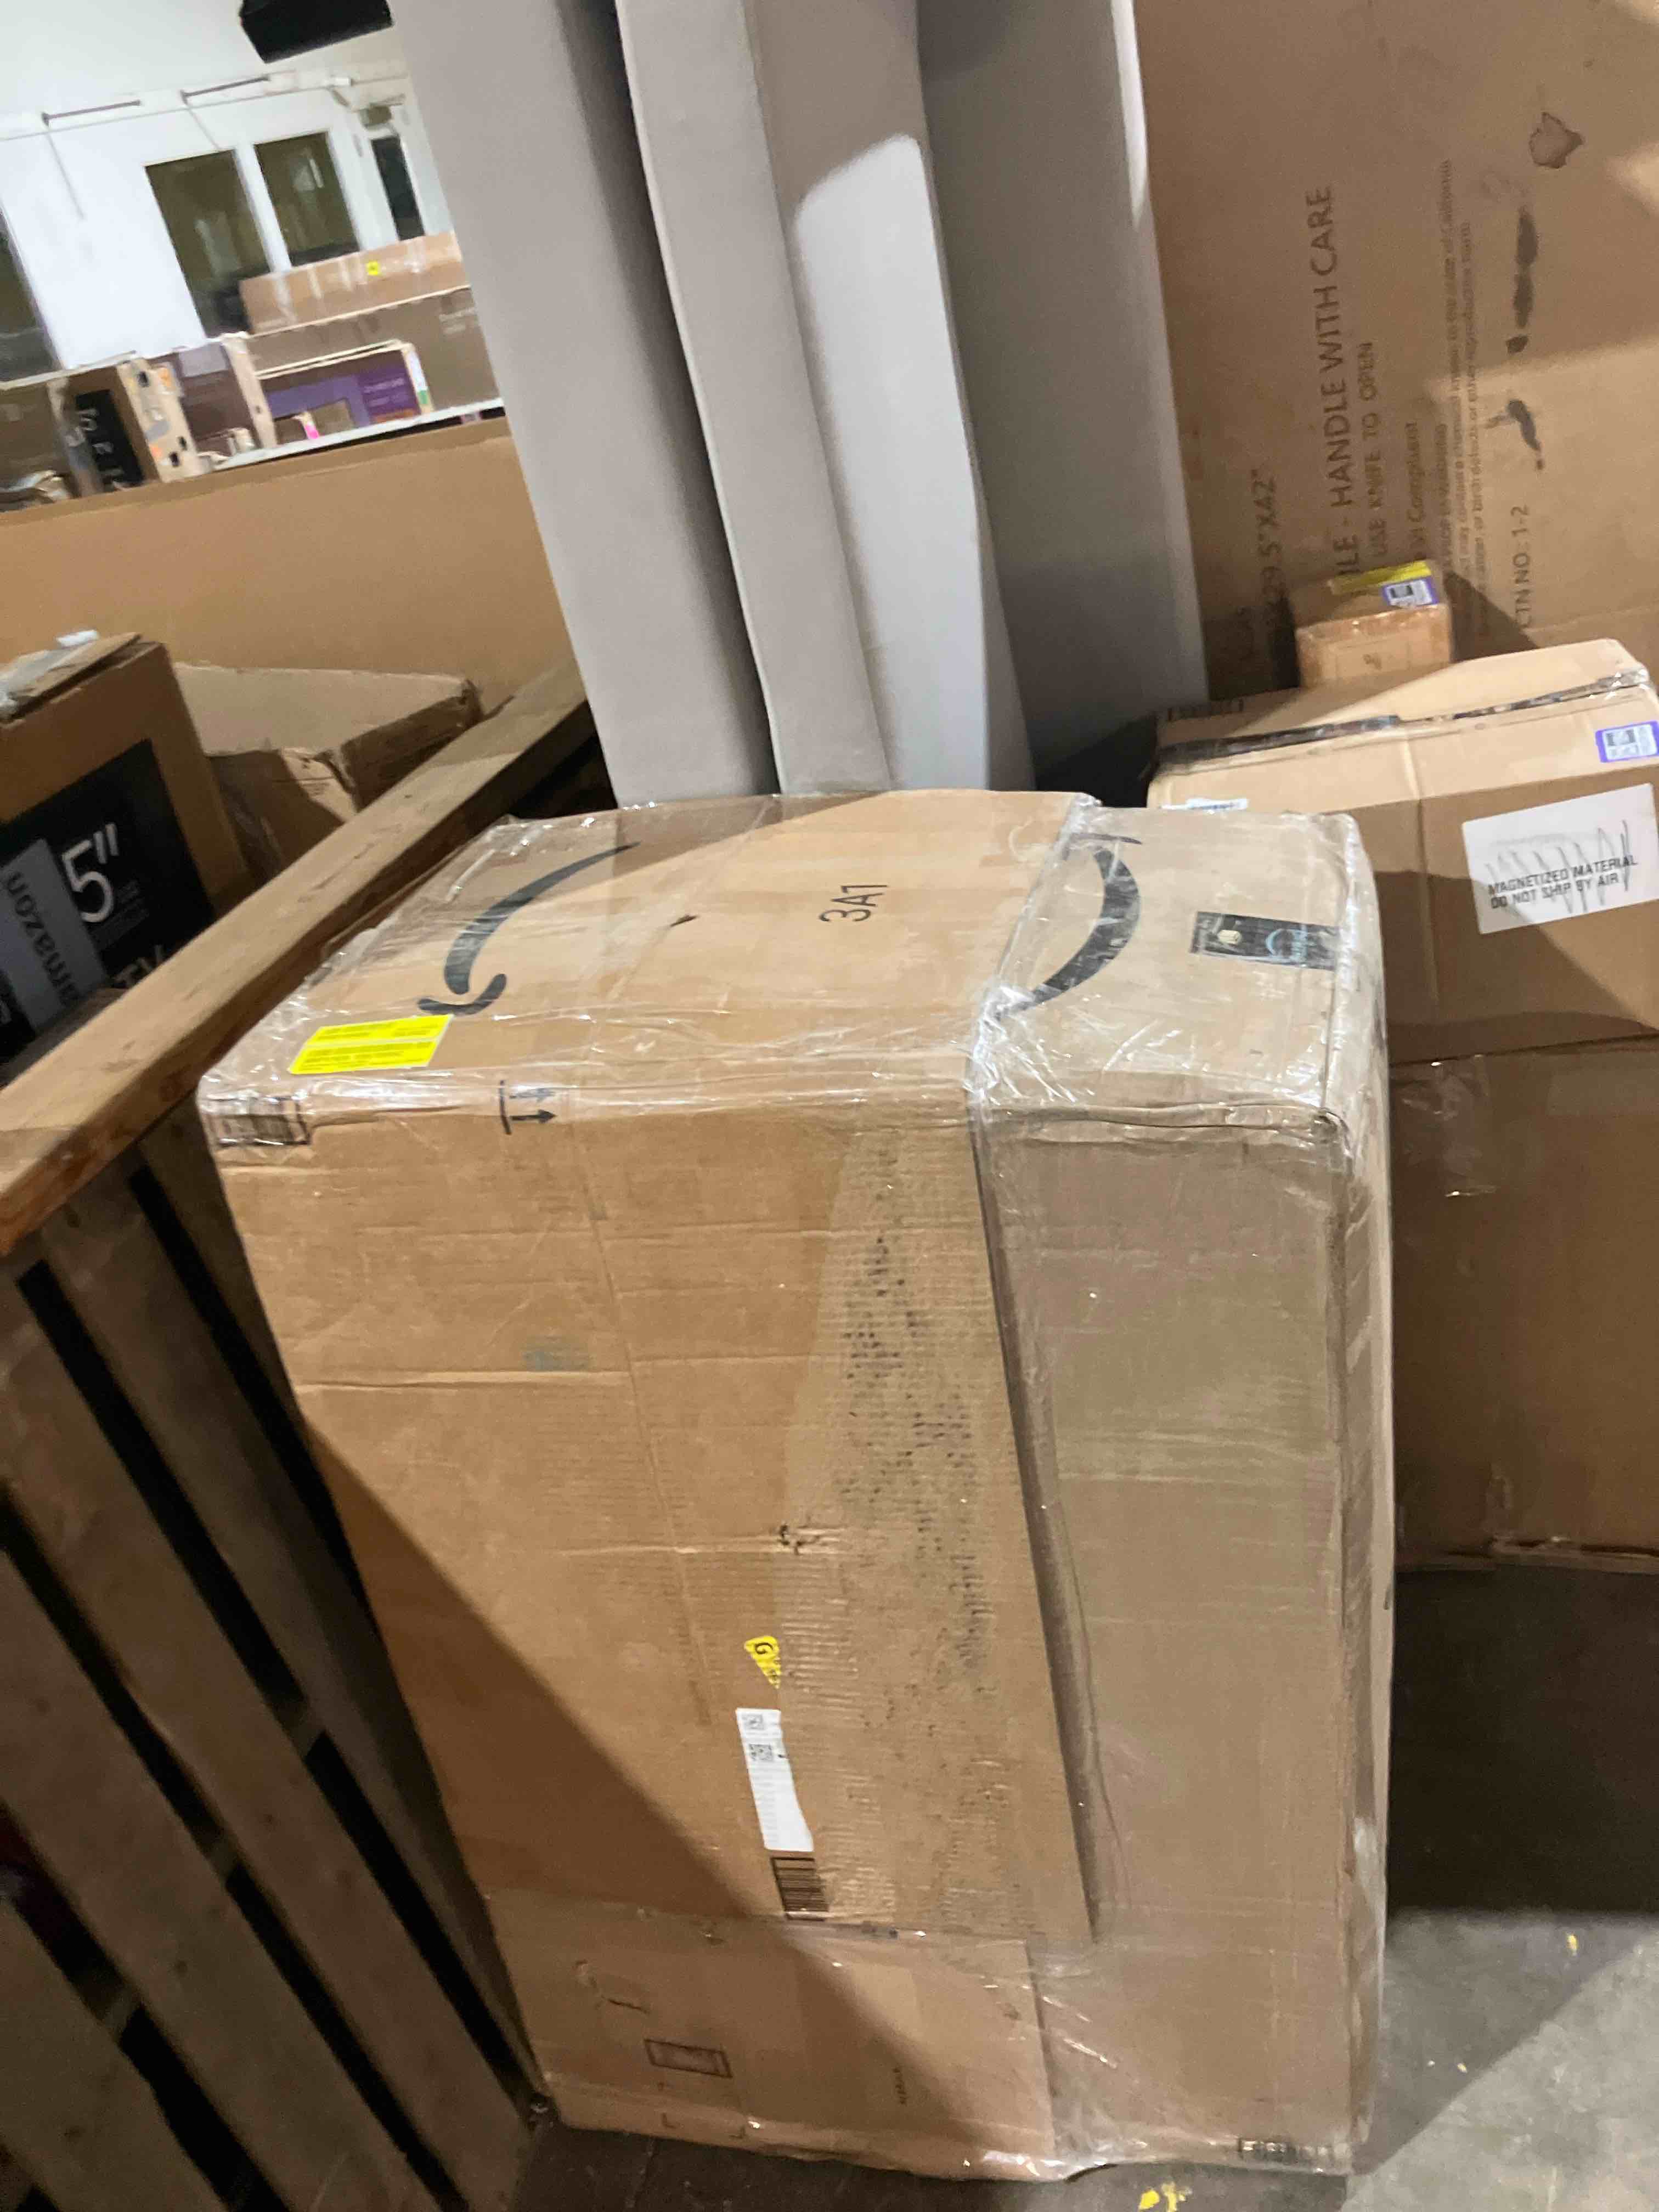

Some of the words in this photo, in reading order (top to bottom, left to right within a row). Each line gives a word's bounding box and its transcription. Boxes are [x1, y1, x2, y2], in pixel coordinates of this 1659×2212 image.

[1305, 187, 1338, 276] CARE
[1313, 285, 1344, 373] WITH
[1358, 341, 1378, 402] OPEN
[1321, 379, 1353, 507] HANDLE
[1362, 413, 1381, 441] TO
[1365, 450, 1384, 509] KNIFE
[1406, 421, 1426, 523] Compliant
[1369, 520, 1388, 557] USE
[1510, 503, 1529, 537] 1-2
[1488, 868, 1569, 895] MAGNETIZED
[1572, 854, 1638, 877] MATERIAL
[1490, 896, 1508, 909] DO
[1511, 889, 1537, 905] NOT
[1541, 882, 1572, 899] SHIP
[1575, 879, 1593, 892] BY
[1597, 872, 1620, 887] AIR
[819, 884, 889, 922] 3A1
